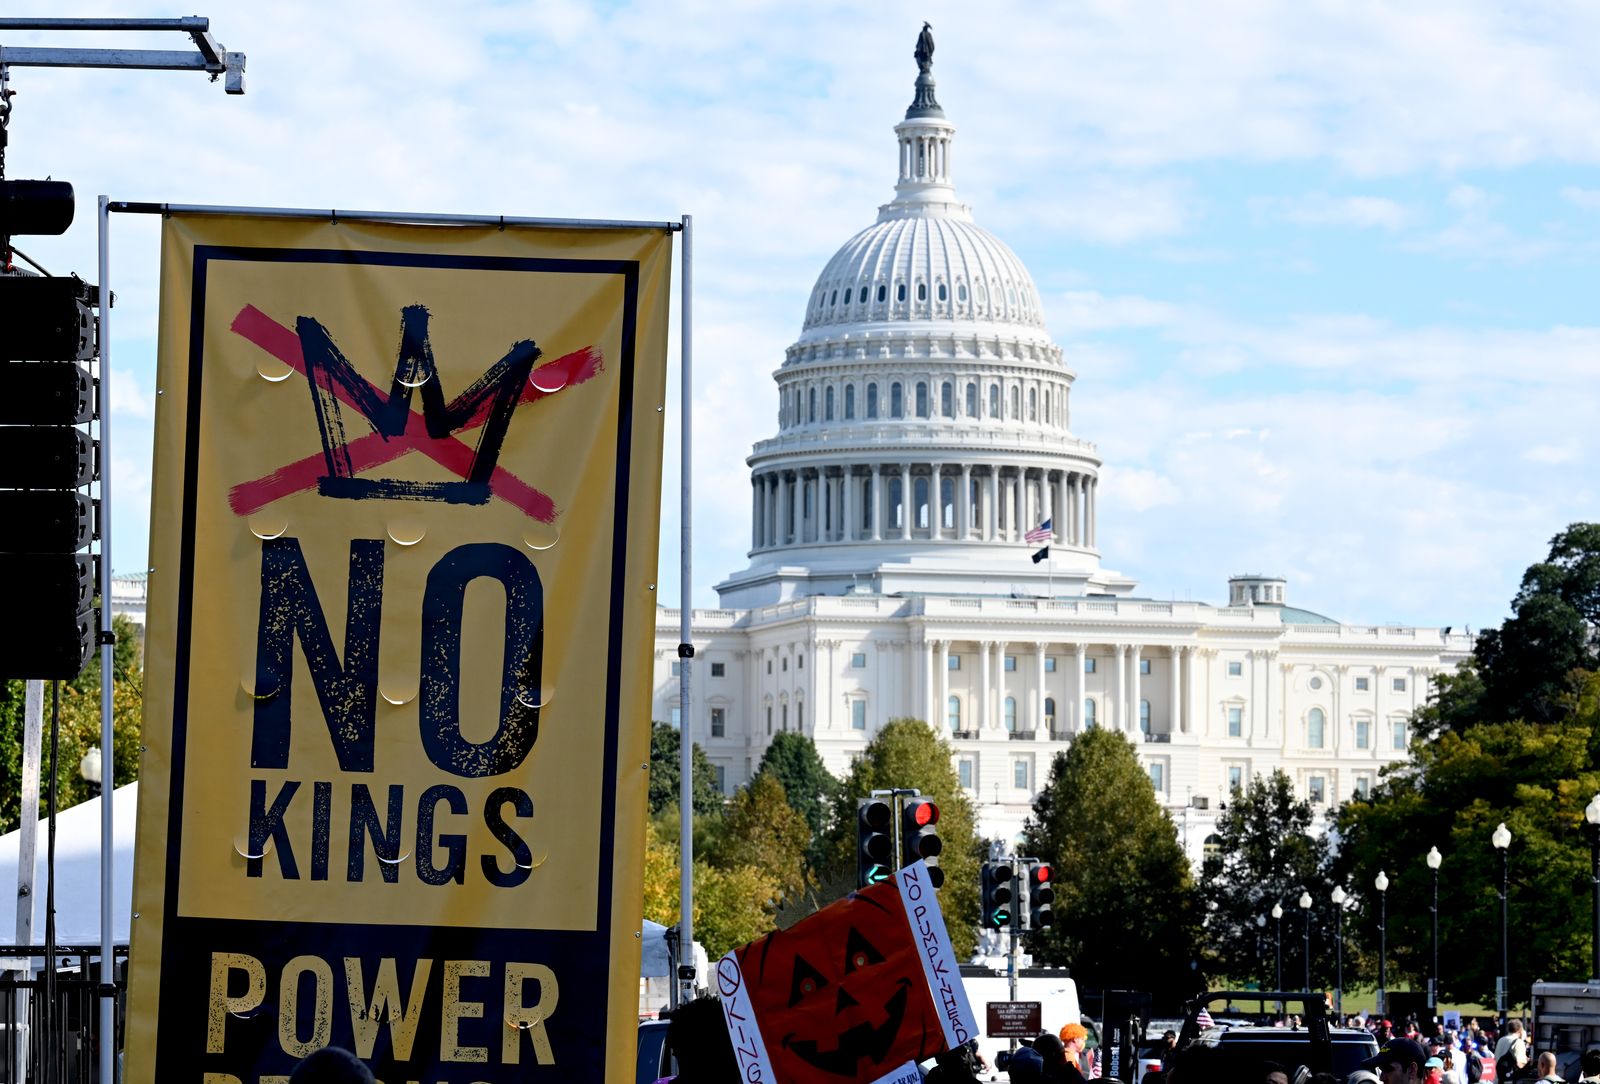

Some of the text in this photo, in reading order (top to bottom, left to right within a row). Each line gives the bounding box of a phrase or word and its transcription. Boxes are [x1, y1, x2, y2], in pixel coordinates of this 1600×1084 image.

[251, 534, 544, 778] NO
[247, 780, 535, 887] KINGS
[903, 868, 922, 901] NO
[206, 951, 560, 1065] POWER
[724, 997, 764, 1084] KING
[1109, 1046, 1120, 1077] Bobcat
